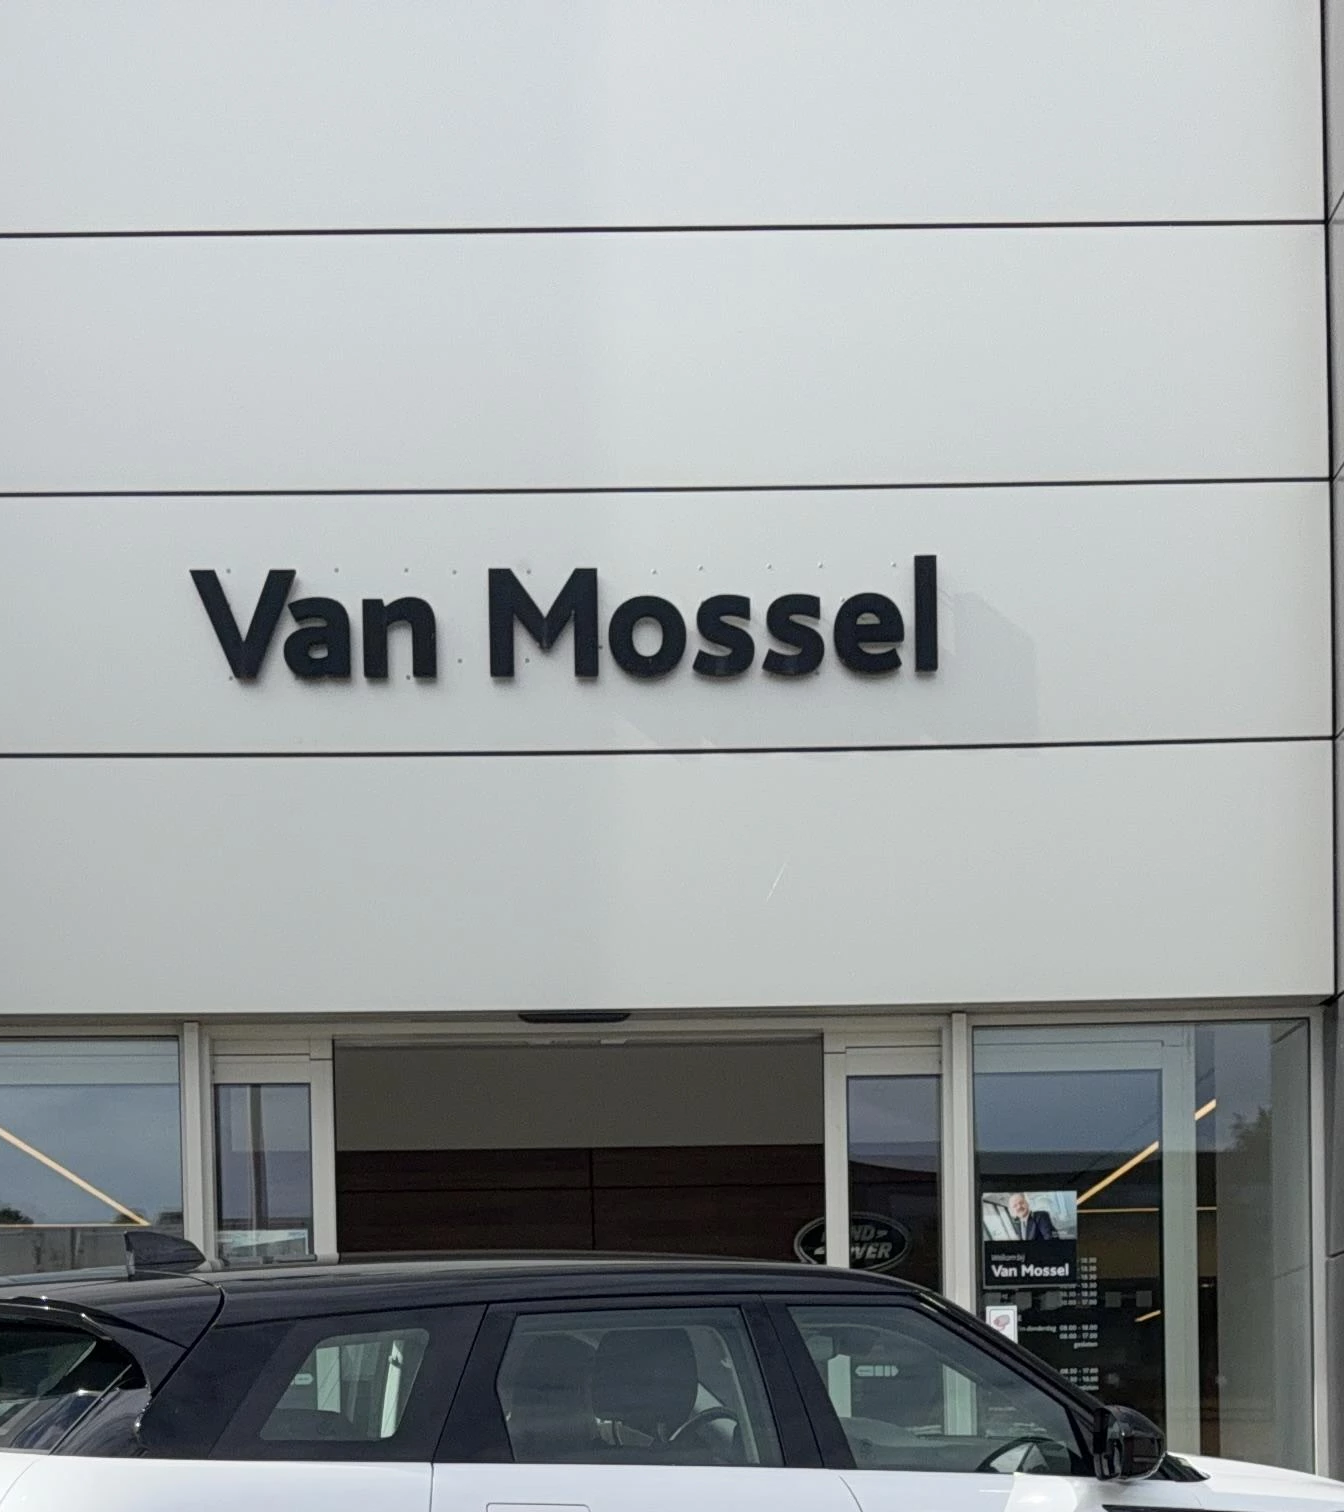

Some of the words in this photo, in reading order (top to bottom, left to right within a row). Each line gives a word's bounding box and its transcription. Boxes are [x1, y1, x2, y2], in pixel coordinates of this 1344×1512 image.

[189, 569, 437, 679] Van
[487, 554, 938, 678] Mossel
[991, 1265, 1018, 1278] Van
[1021, 1263, 1070, 1278] Mossel
